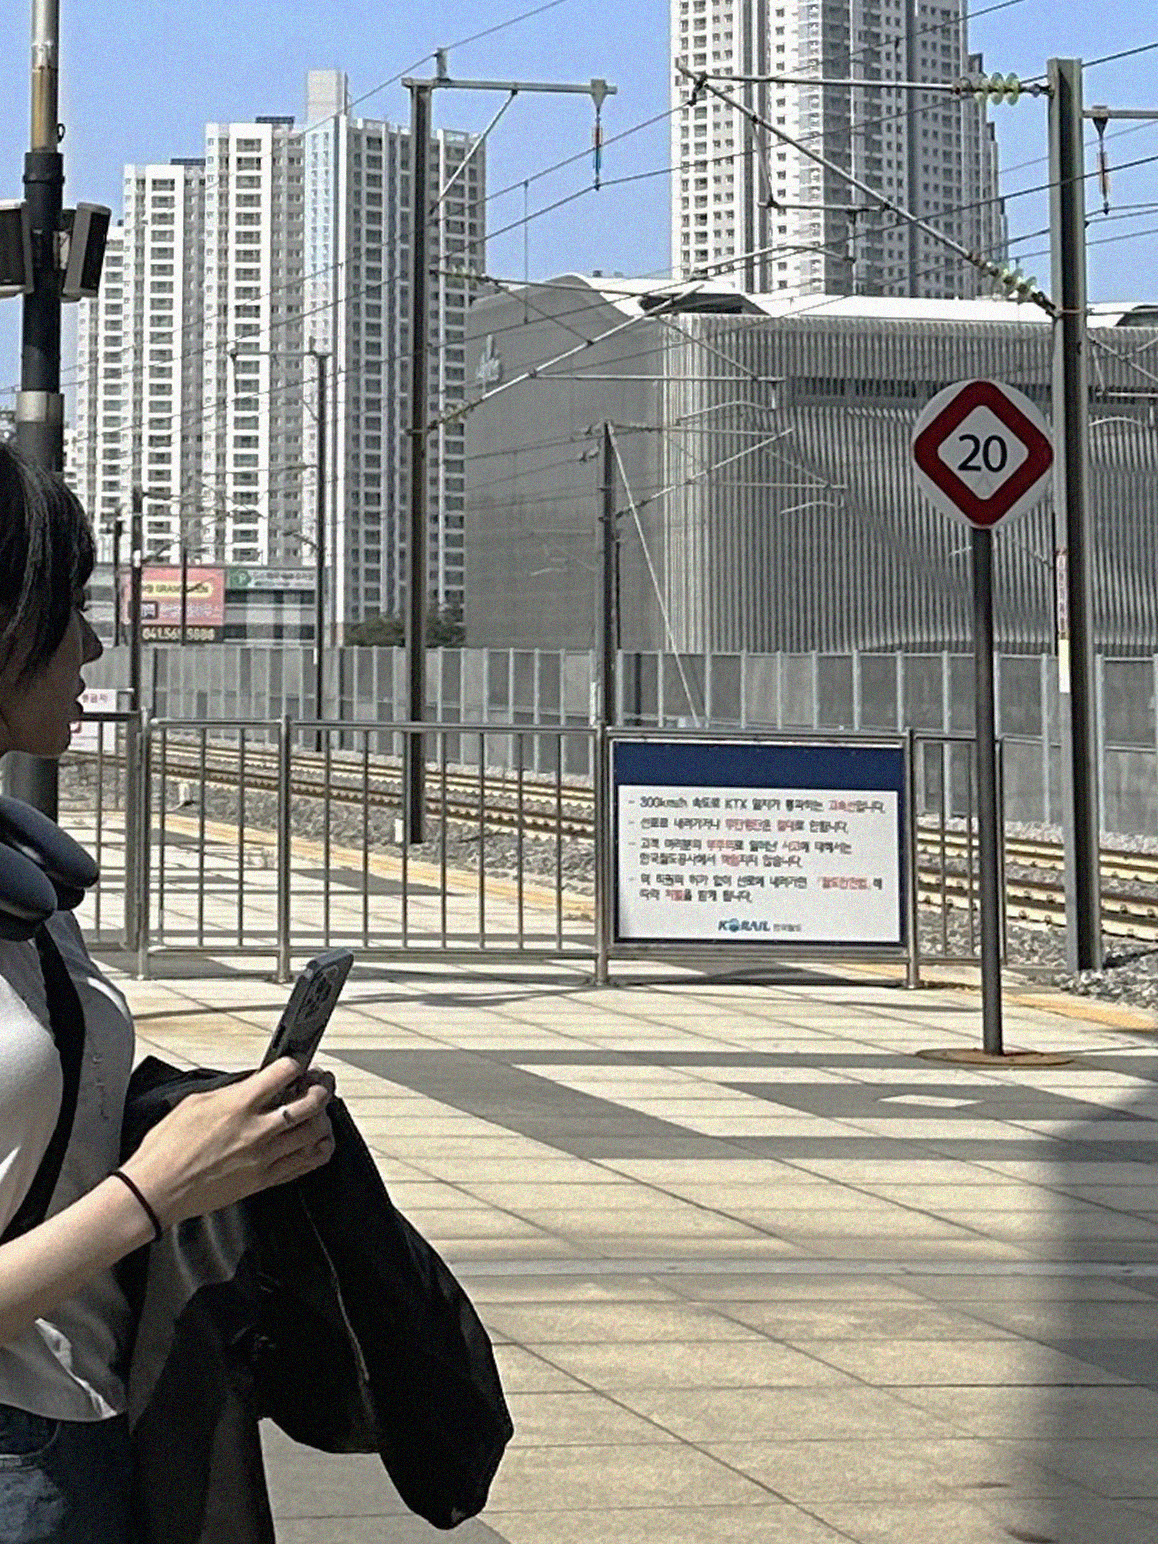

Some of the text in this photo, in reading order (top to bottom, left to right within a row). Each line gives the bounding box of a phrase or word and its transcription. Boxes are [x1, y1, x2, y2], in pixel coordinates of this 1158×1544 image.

[958, 434, 1007, 472] 20
[725, 799, 747, 809] KTX
[718, 919, 770, 932] KORAIL
